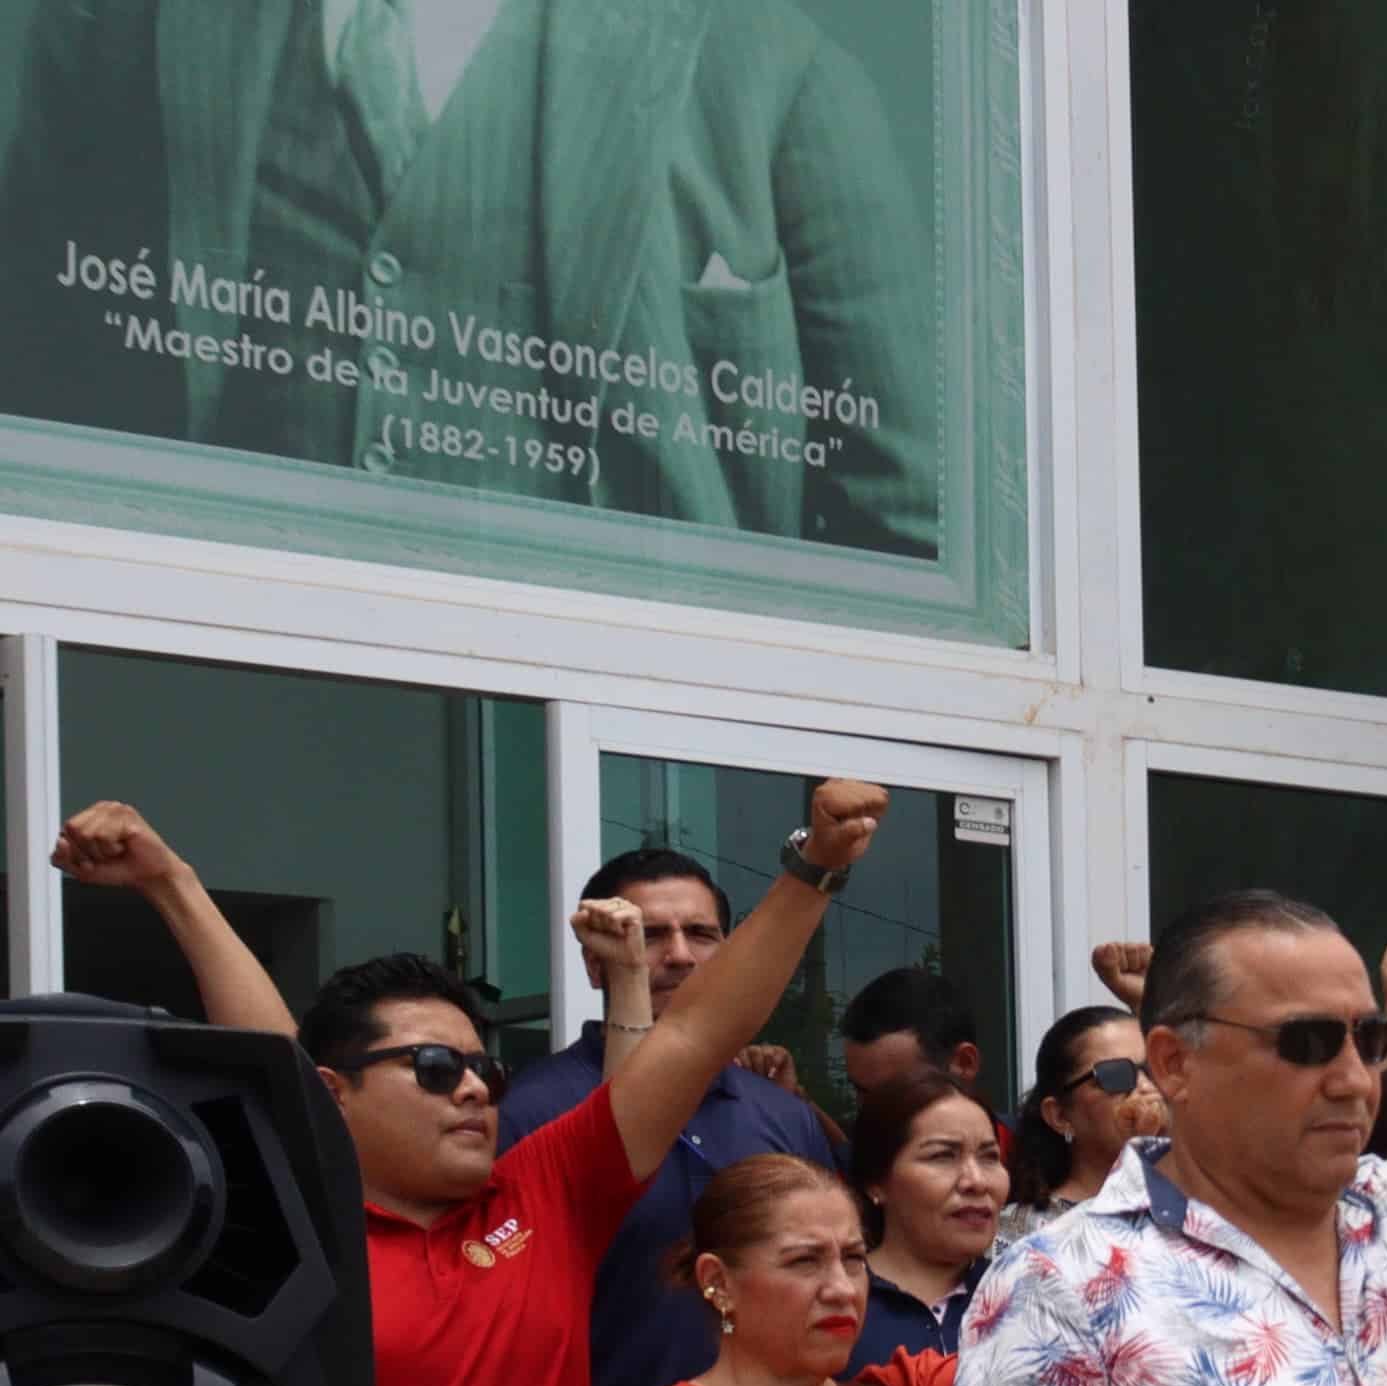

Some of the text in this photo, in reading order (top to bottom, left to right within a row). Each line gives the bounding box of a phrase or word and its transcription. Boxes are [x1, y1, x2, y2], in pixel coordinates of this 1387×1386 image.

[57, 240, 879, 429] José María Albino Vasconcelos Calderón
[306, 349, 361, 387] de
[371, 355, 409, 396] la
[422, 369, 598, 429] Juventud
[610, 402, 660, 439] de
[382, 413, 600, 486] (1882-1959)
[485, 1218, 519, 1247] SEP
